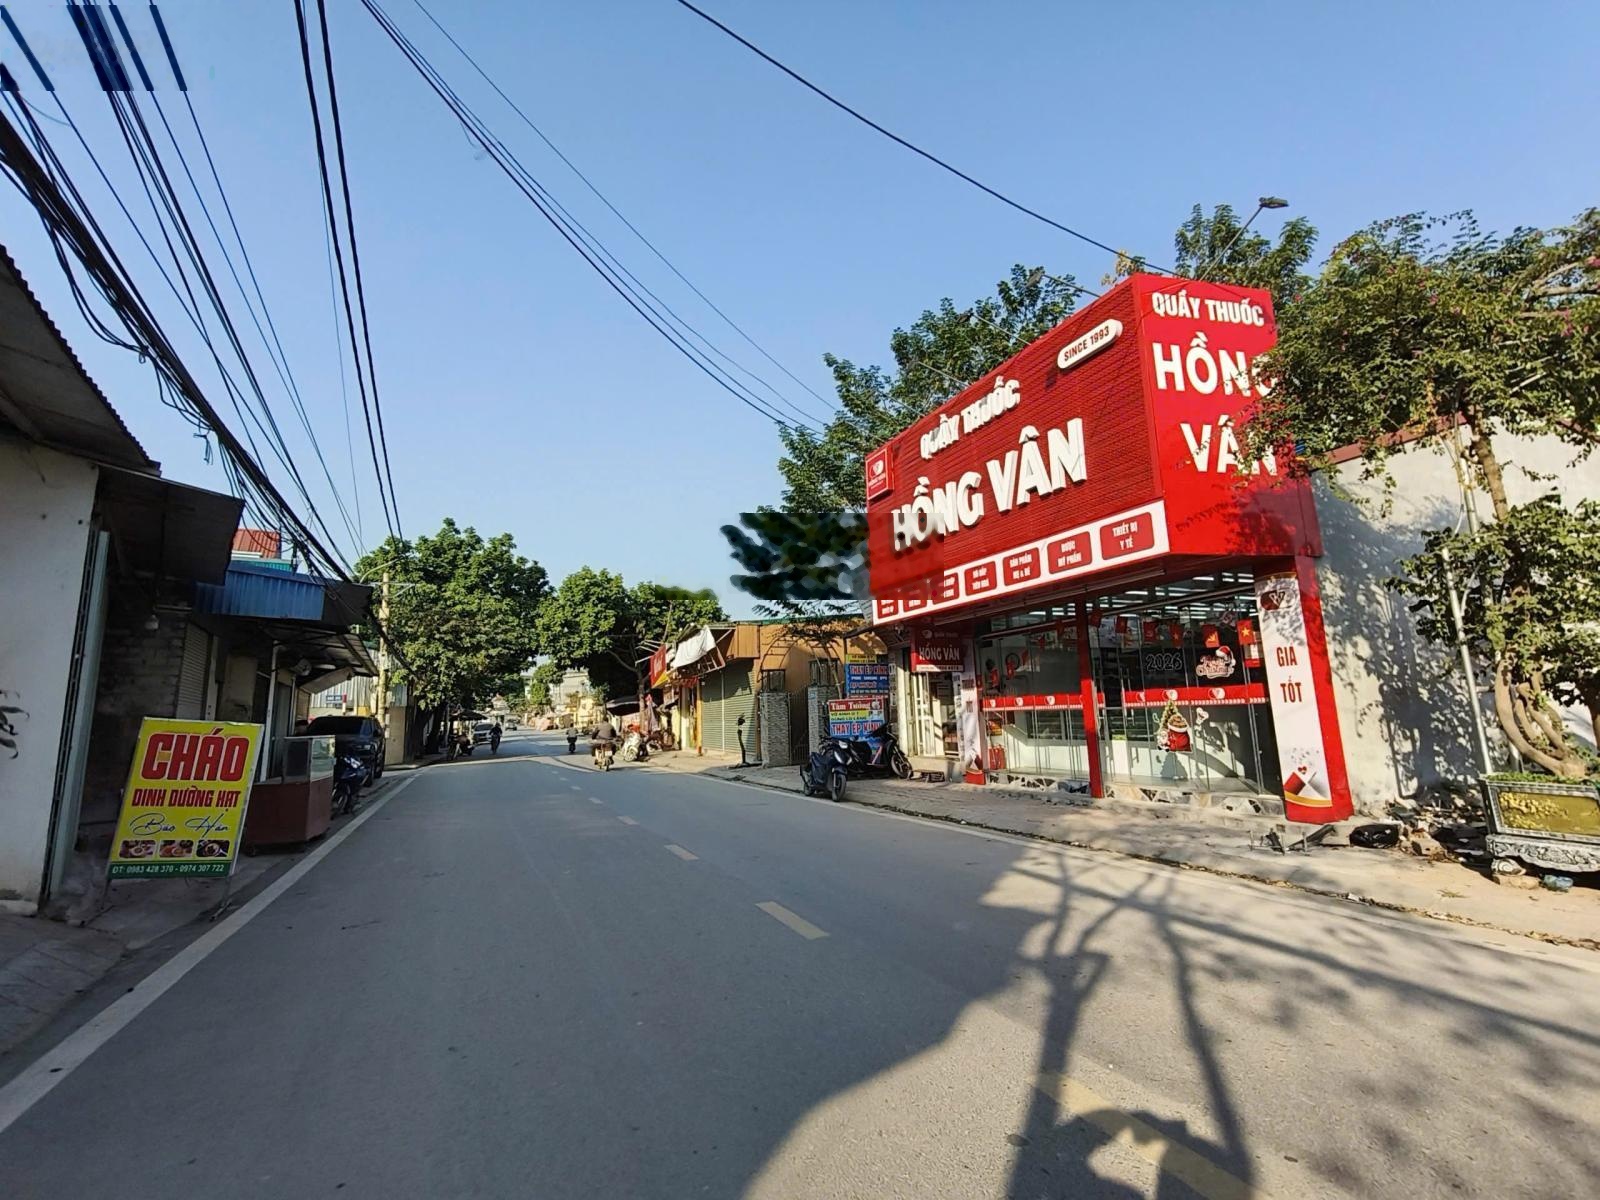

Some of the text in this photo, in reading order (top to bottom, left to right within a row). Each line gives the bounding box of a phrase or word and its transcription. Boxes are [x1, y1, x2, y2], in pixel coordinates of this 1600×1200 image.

[1205, 298, 1264, 327] THUỐC
[1064, 325, 1110, 361] SINCE 1993
[961, 376, 1021, 434] THUỐC
[891, 417, 1087, 551] HỒNG VÂN
[1146, 653, 1183, 672] 2026
[1280, 675, 1302, 703] TỐT
[831, 723, 850, 735] THAY
[141, 727, 250, 782] CHÁO
[132, 788, 167, 807] DINH
[168, 785, 215, 808] DƯỠNG
[211, 863, 224, 872] 722
